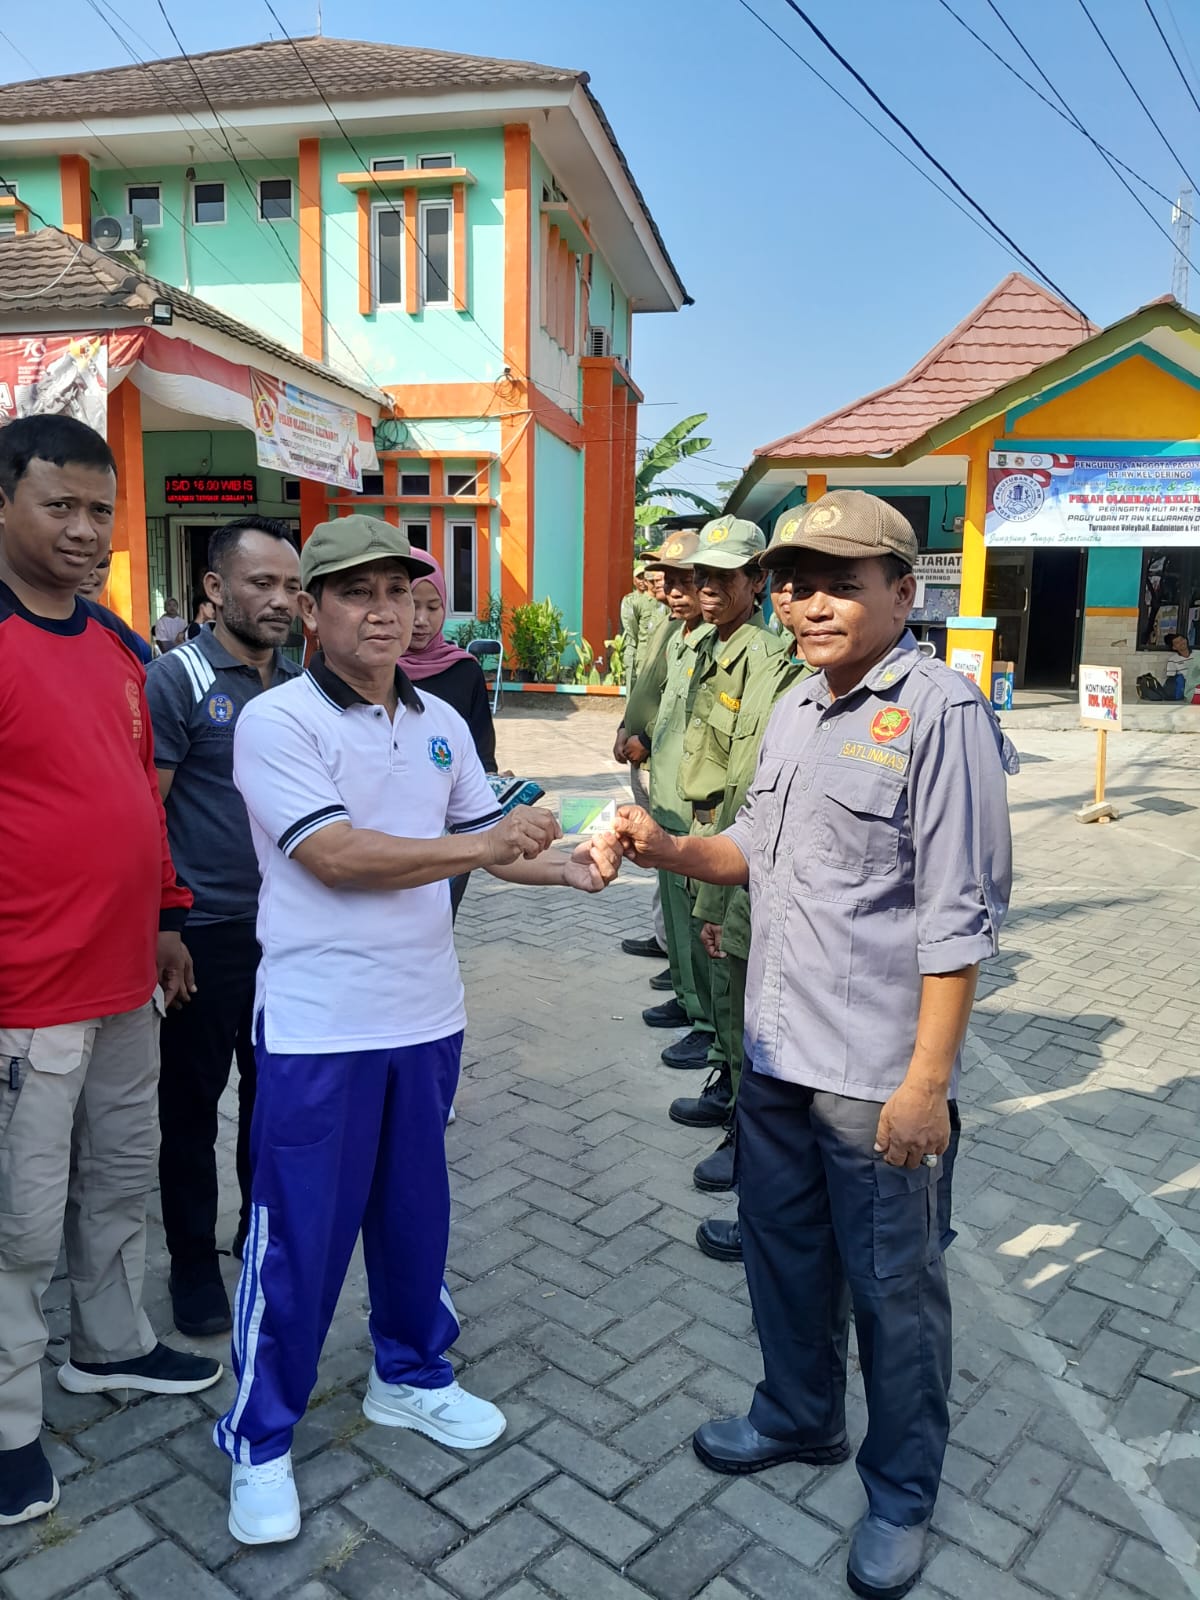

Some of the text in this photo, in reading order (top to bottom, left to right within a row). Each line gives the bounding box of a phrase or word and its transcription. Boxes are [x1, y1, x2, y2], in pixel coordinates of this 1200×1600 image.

[1075, 461, 1119, 469] PENGURUS
[1122, 461, 1128, 469] &
[1131, 462, 1170, 470] ANGGOTA
[1154, 471, 1192, 479] DERINGO
[221, 480, 242, 491] WIB
[995, 475, 1028, 500] PAGUYUBAN
[1105, 480, 1162, 492] Selamat
[1166, 480, 1177, 491] &
[1068, 494, 1104, 504] PEKAN
[1106, 494, 1162, 504] OLAHRAGA
[997, 506, 1011, 519] KOTA
[1099, 505, 1150, 513] PERINGATAN
[1152, 505, 1167, 513] HUT
[1067, 514, 1117, 522] PAGUYUBAN
[1146, 514, 1194, 522] KELURAHAN
[1088, 523, 1120, 532] Turnamen
[1151, 523, 1185, 532] Badminton
[995, 681, 1004, 700] AQUA
[1085, 684, 1116, 695] KONTINGEN
[842, 743, 905, 771] SATLINMAS
